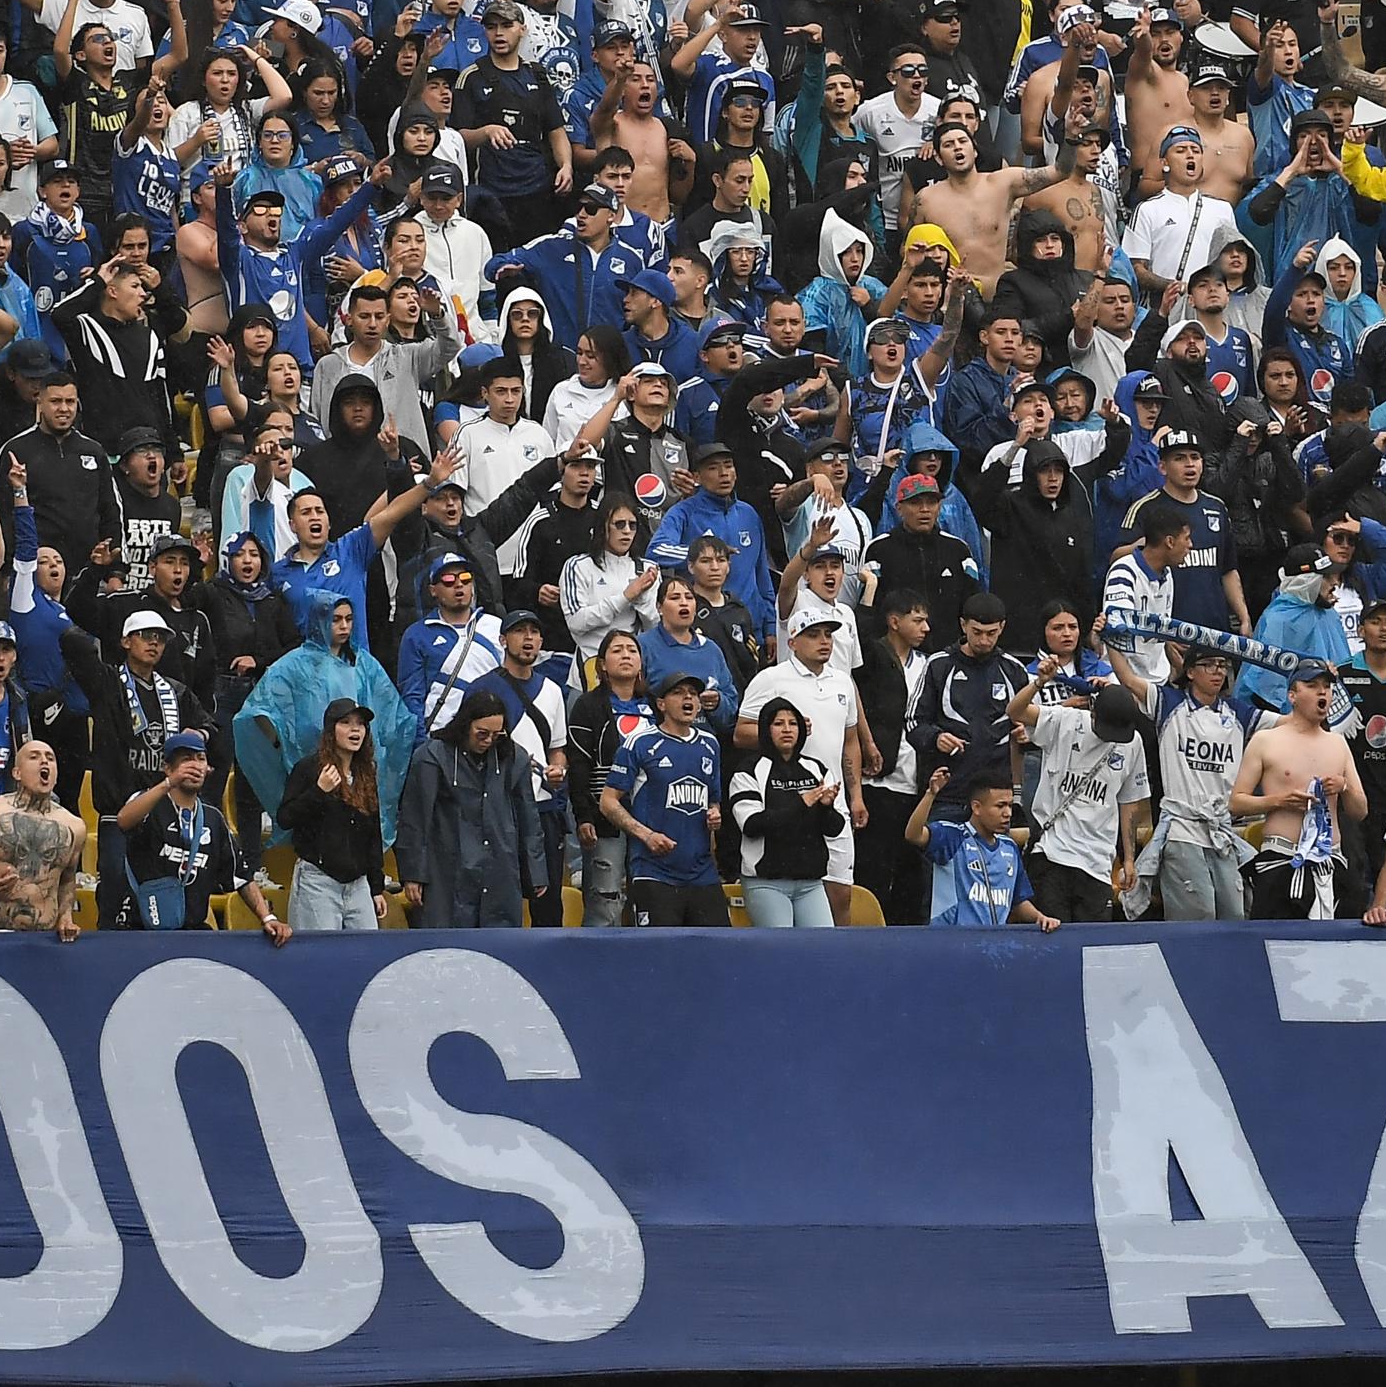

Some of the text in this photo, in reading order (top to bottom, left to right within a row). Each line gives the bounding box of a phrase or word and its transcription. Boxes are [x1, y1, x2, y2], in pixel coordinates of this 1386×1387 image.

[90, 111, 127, 132] ANDIN
[127, 518, 171, 535] ESTE
[127, 747, 164, 772] RAIDE
[1177, 735, 1235, 763] LEONA
[667, 784, 708, 804] ANDINA
